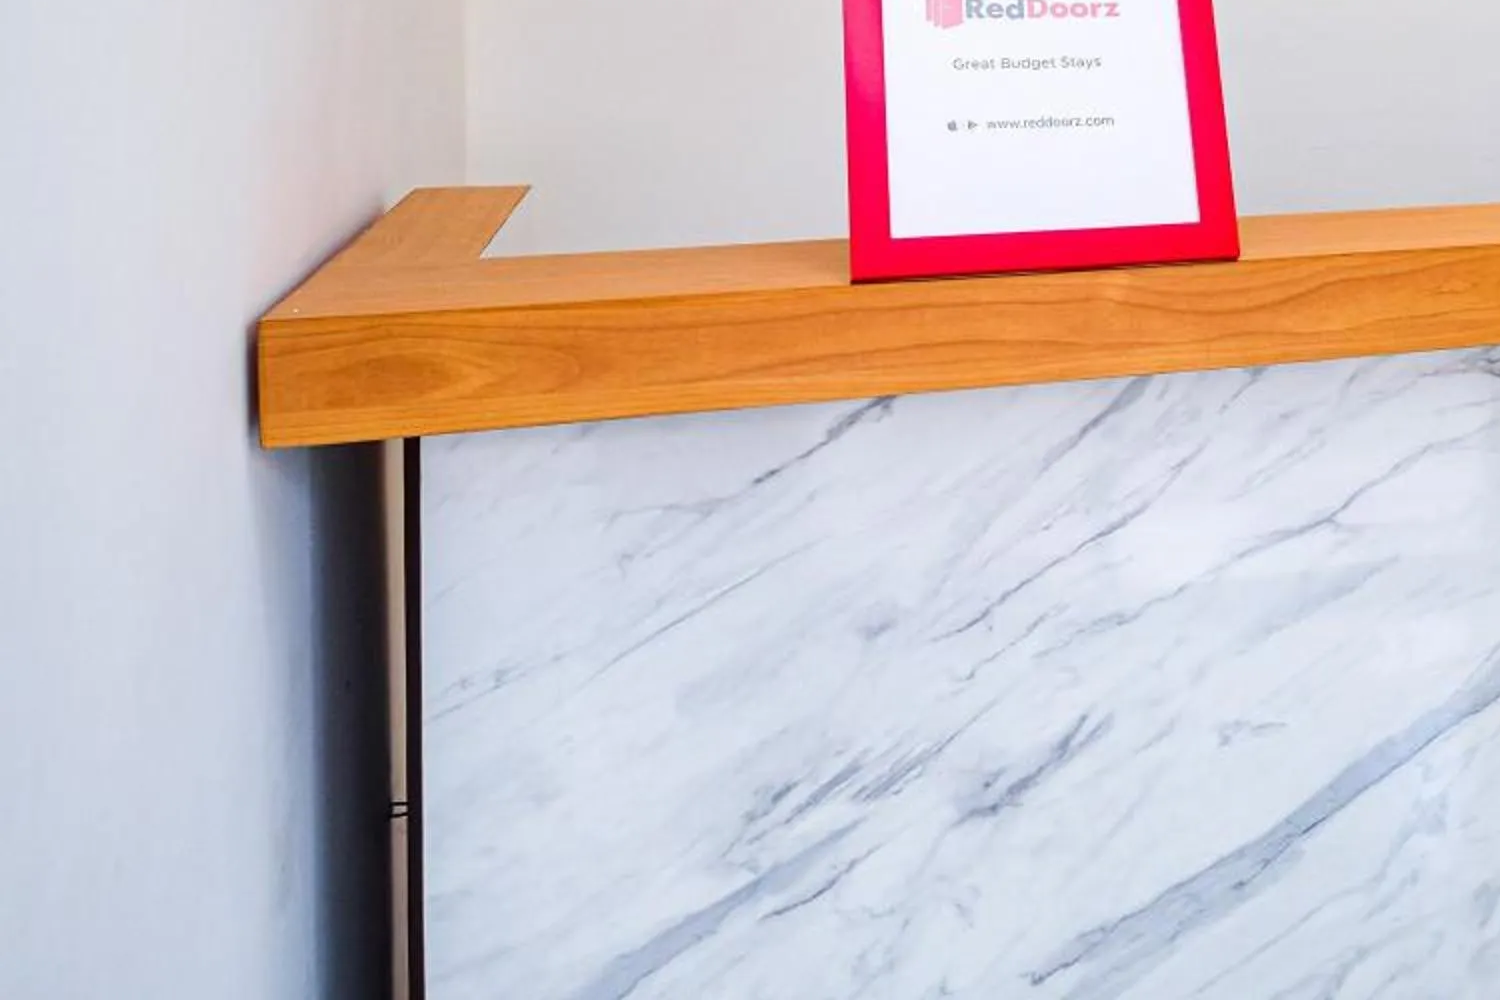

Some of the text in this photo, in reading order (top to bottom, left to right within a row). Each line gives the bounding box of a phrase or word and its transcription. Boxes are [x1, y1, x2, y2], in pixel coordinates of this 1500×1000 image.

[952, 55, 1102, 71] Great Budget Stays
[987, 115, 1115, 129] www.reddoorz.com
